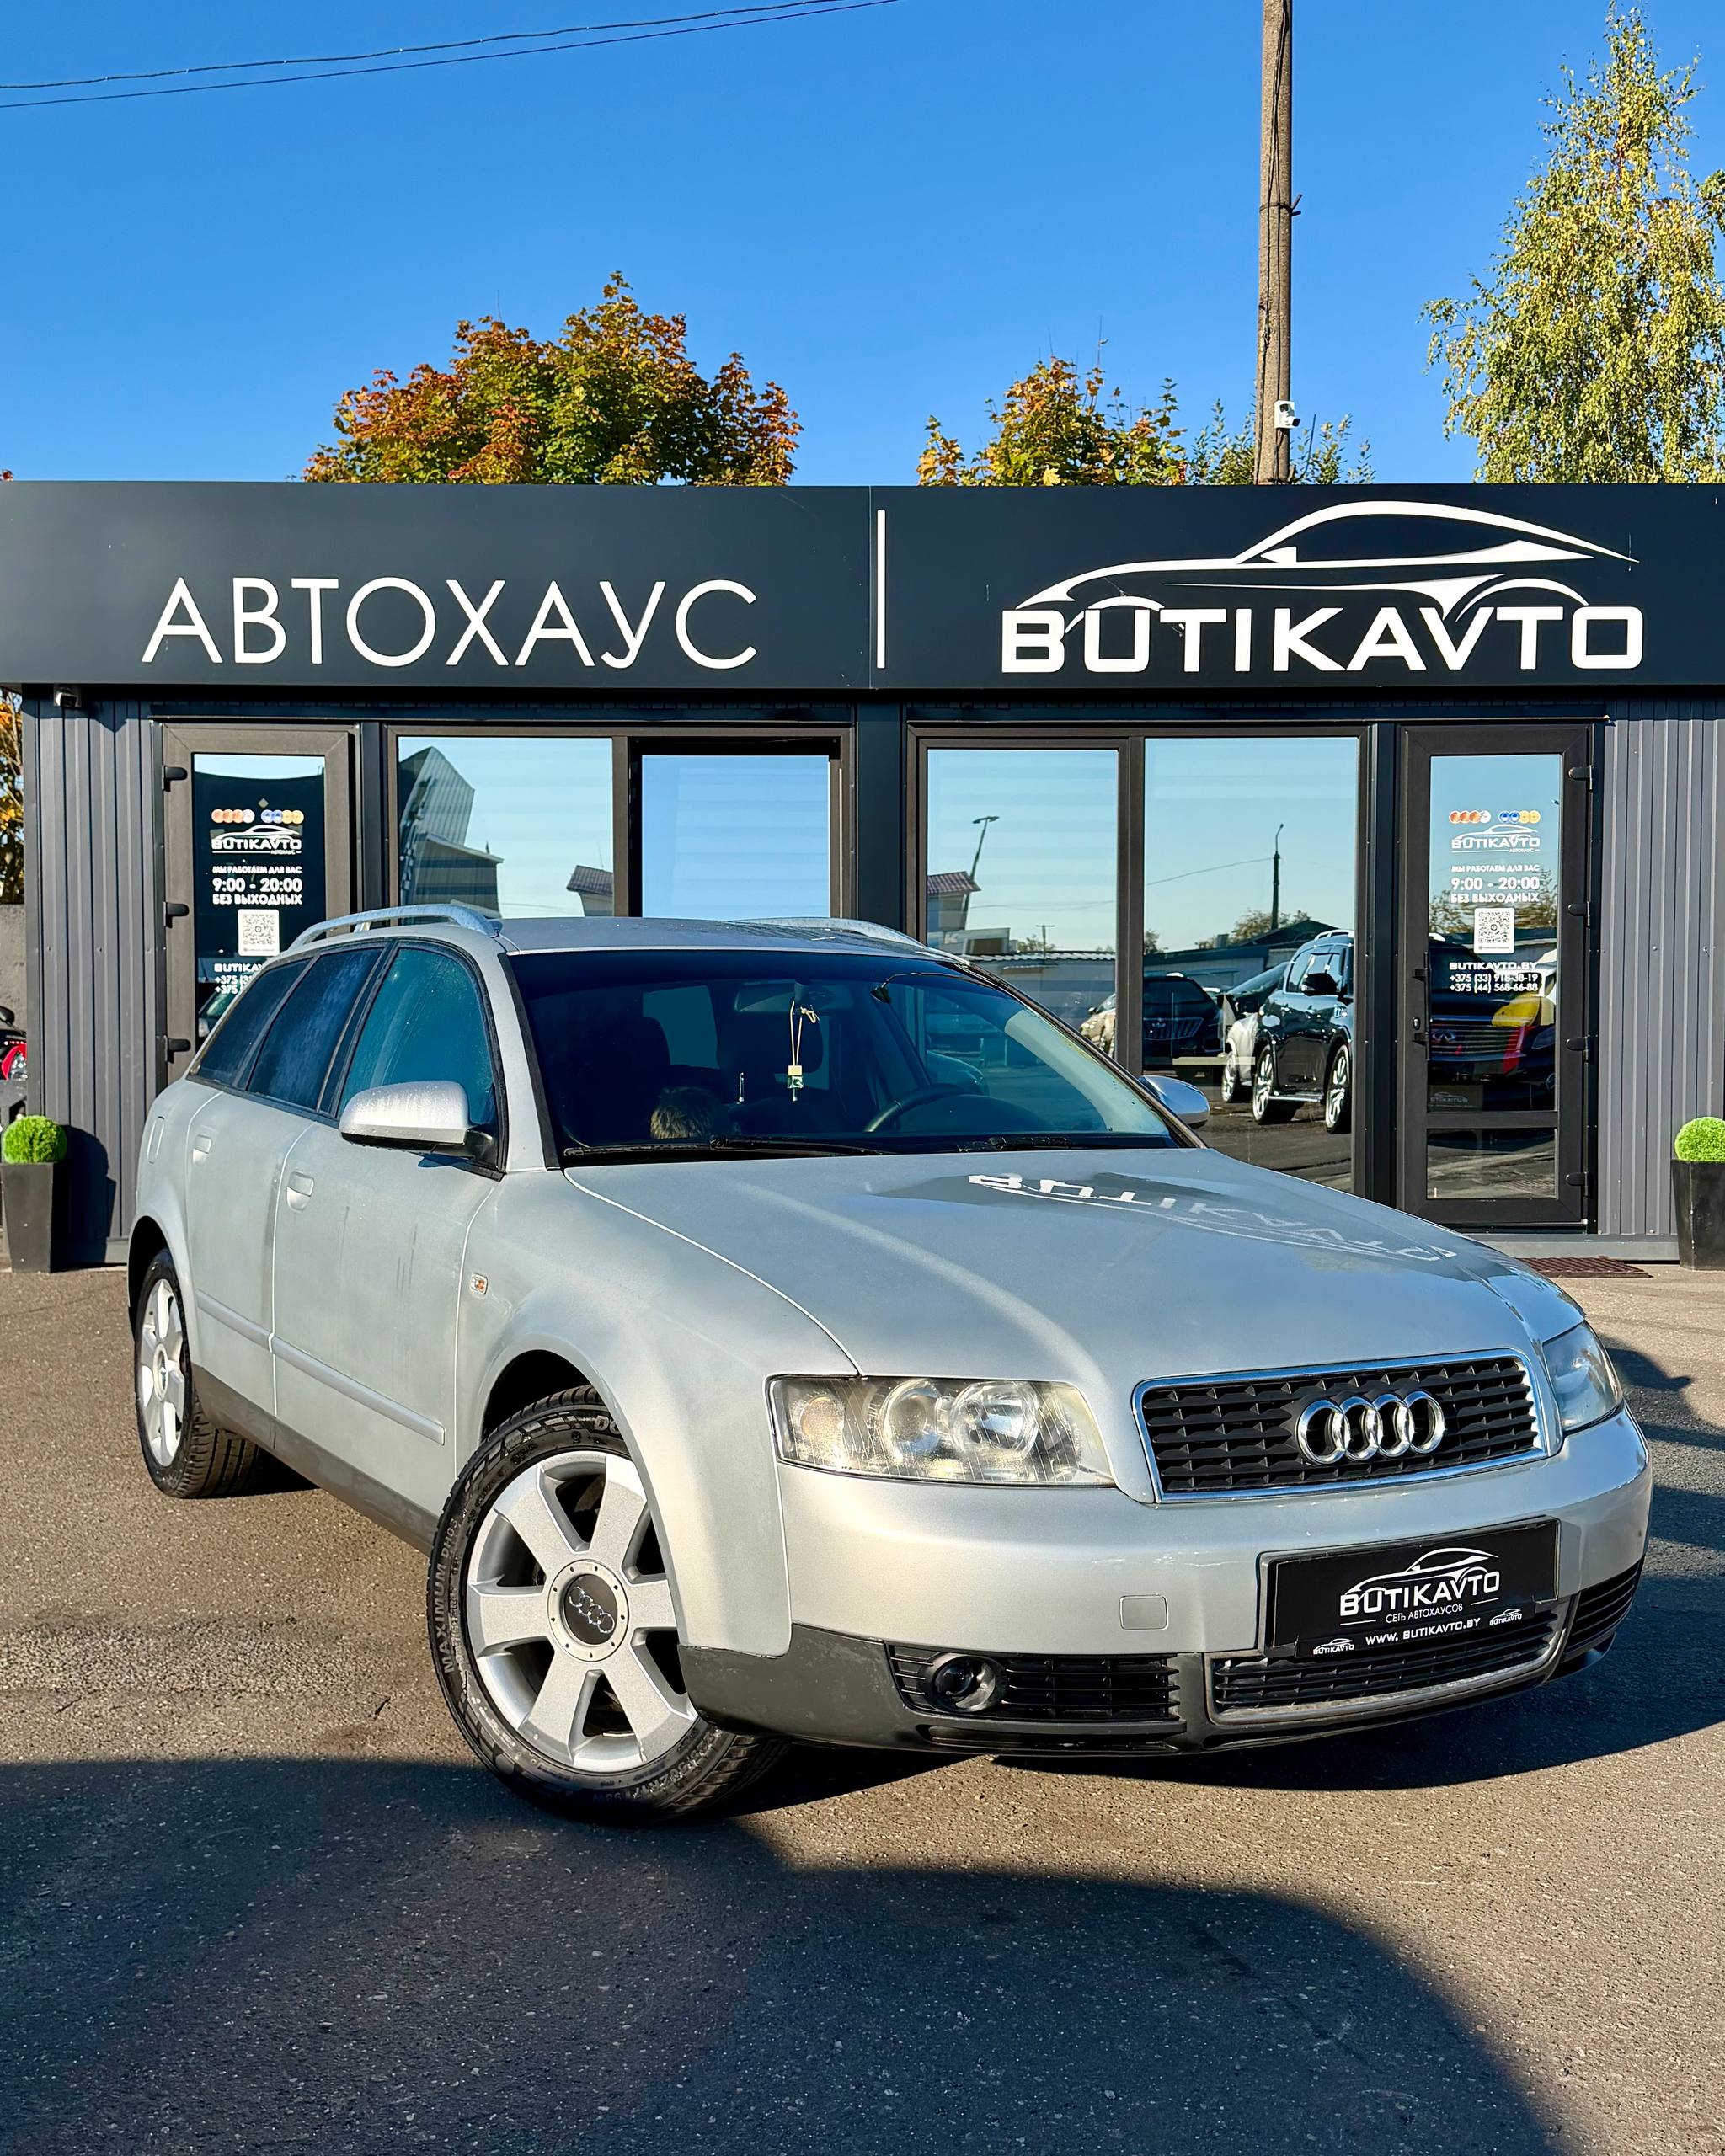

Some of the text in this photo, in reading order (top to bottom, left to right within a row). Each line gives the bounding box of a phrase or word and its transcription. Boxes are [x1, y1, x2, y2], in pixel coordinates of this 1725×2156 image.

[141, 576, 758, 670] АВТОХАУС
[1001, 606, 1644, 673] BUTIKAVTO
[211, 838, 302, 850] BUTIKAVTO
[1451, 837, 1541, 849] BUTIKAVTO
[212, 878, 245, 892] 9:00
[259, 878, 302, 892] 20:00
[1451, 877, 1482, 890] 9:00
[1498, 876, 1540, 890] 20:00
[212, 894, 302, 905] БЕЗ ВЫХОДНЫХ
[1450, 892, 1540, 904] БЕЗ ВЫХОДНЫХ
[215, 975, 238, 985] +375
[1449, 974, 1471, 982] +375
[1474, 974, 1491, 984] (33)
[215, 985, 238, 994] +375
[1449, 984, 1471, 992] +375
[1474, 983, 1491, 994] (44)
[1340, 1570, 1500, 1616] BUTIKAVTO
[435, 1563, 455, 1674] MAXIMUM
[1386, 1604, 1463, 1624] СЕТЬ АВТОХАУСОВ
[1489, 1613, 1523, 1625] BUTIKAVTO
[1365, 1617, 1481, 1646] WWW. BUTIKAVTO.BY
[1313, 1643, 1355, 1655] BUTIKAVTO
